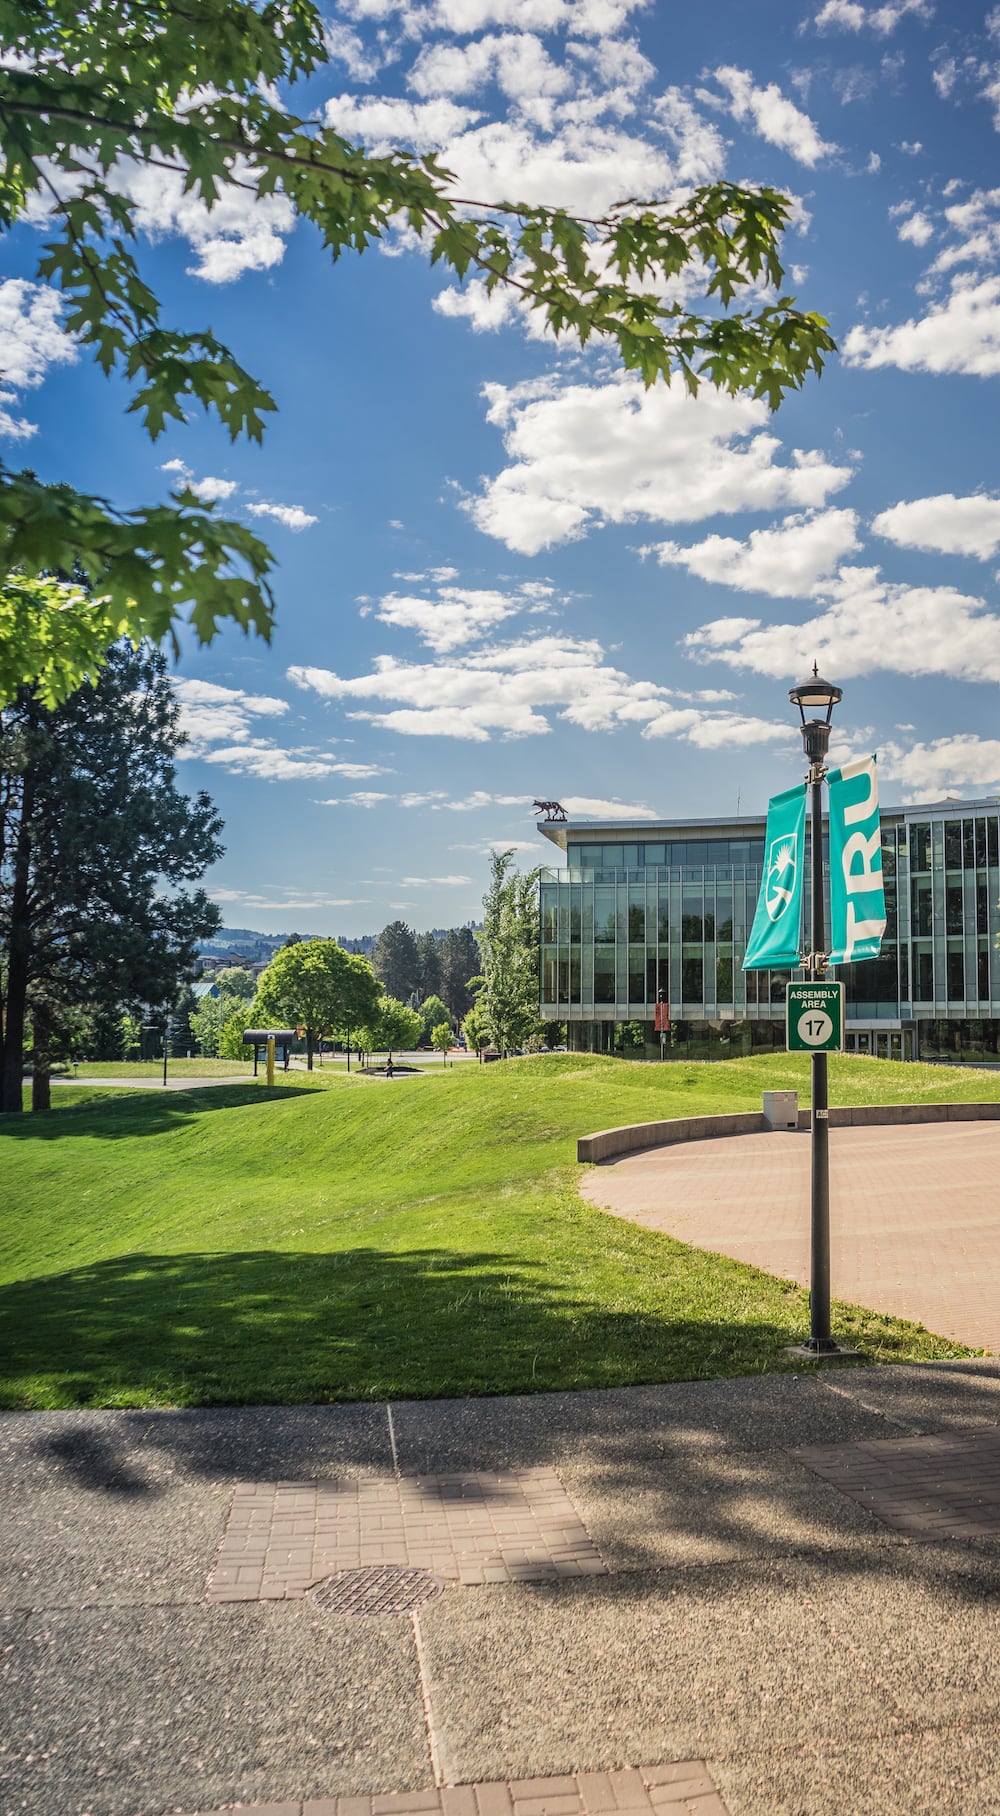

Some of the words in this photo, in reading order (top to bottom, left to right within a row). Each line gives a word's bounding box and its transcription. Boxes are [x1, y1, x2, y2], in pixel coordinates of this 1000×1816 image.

[842, 755, 886, 963] TRU
[790, 990, 838, 999] ASSEMBLY
[801, 1000, 827, 1009] AREA
[805, 1020, 825, 1036] 17
